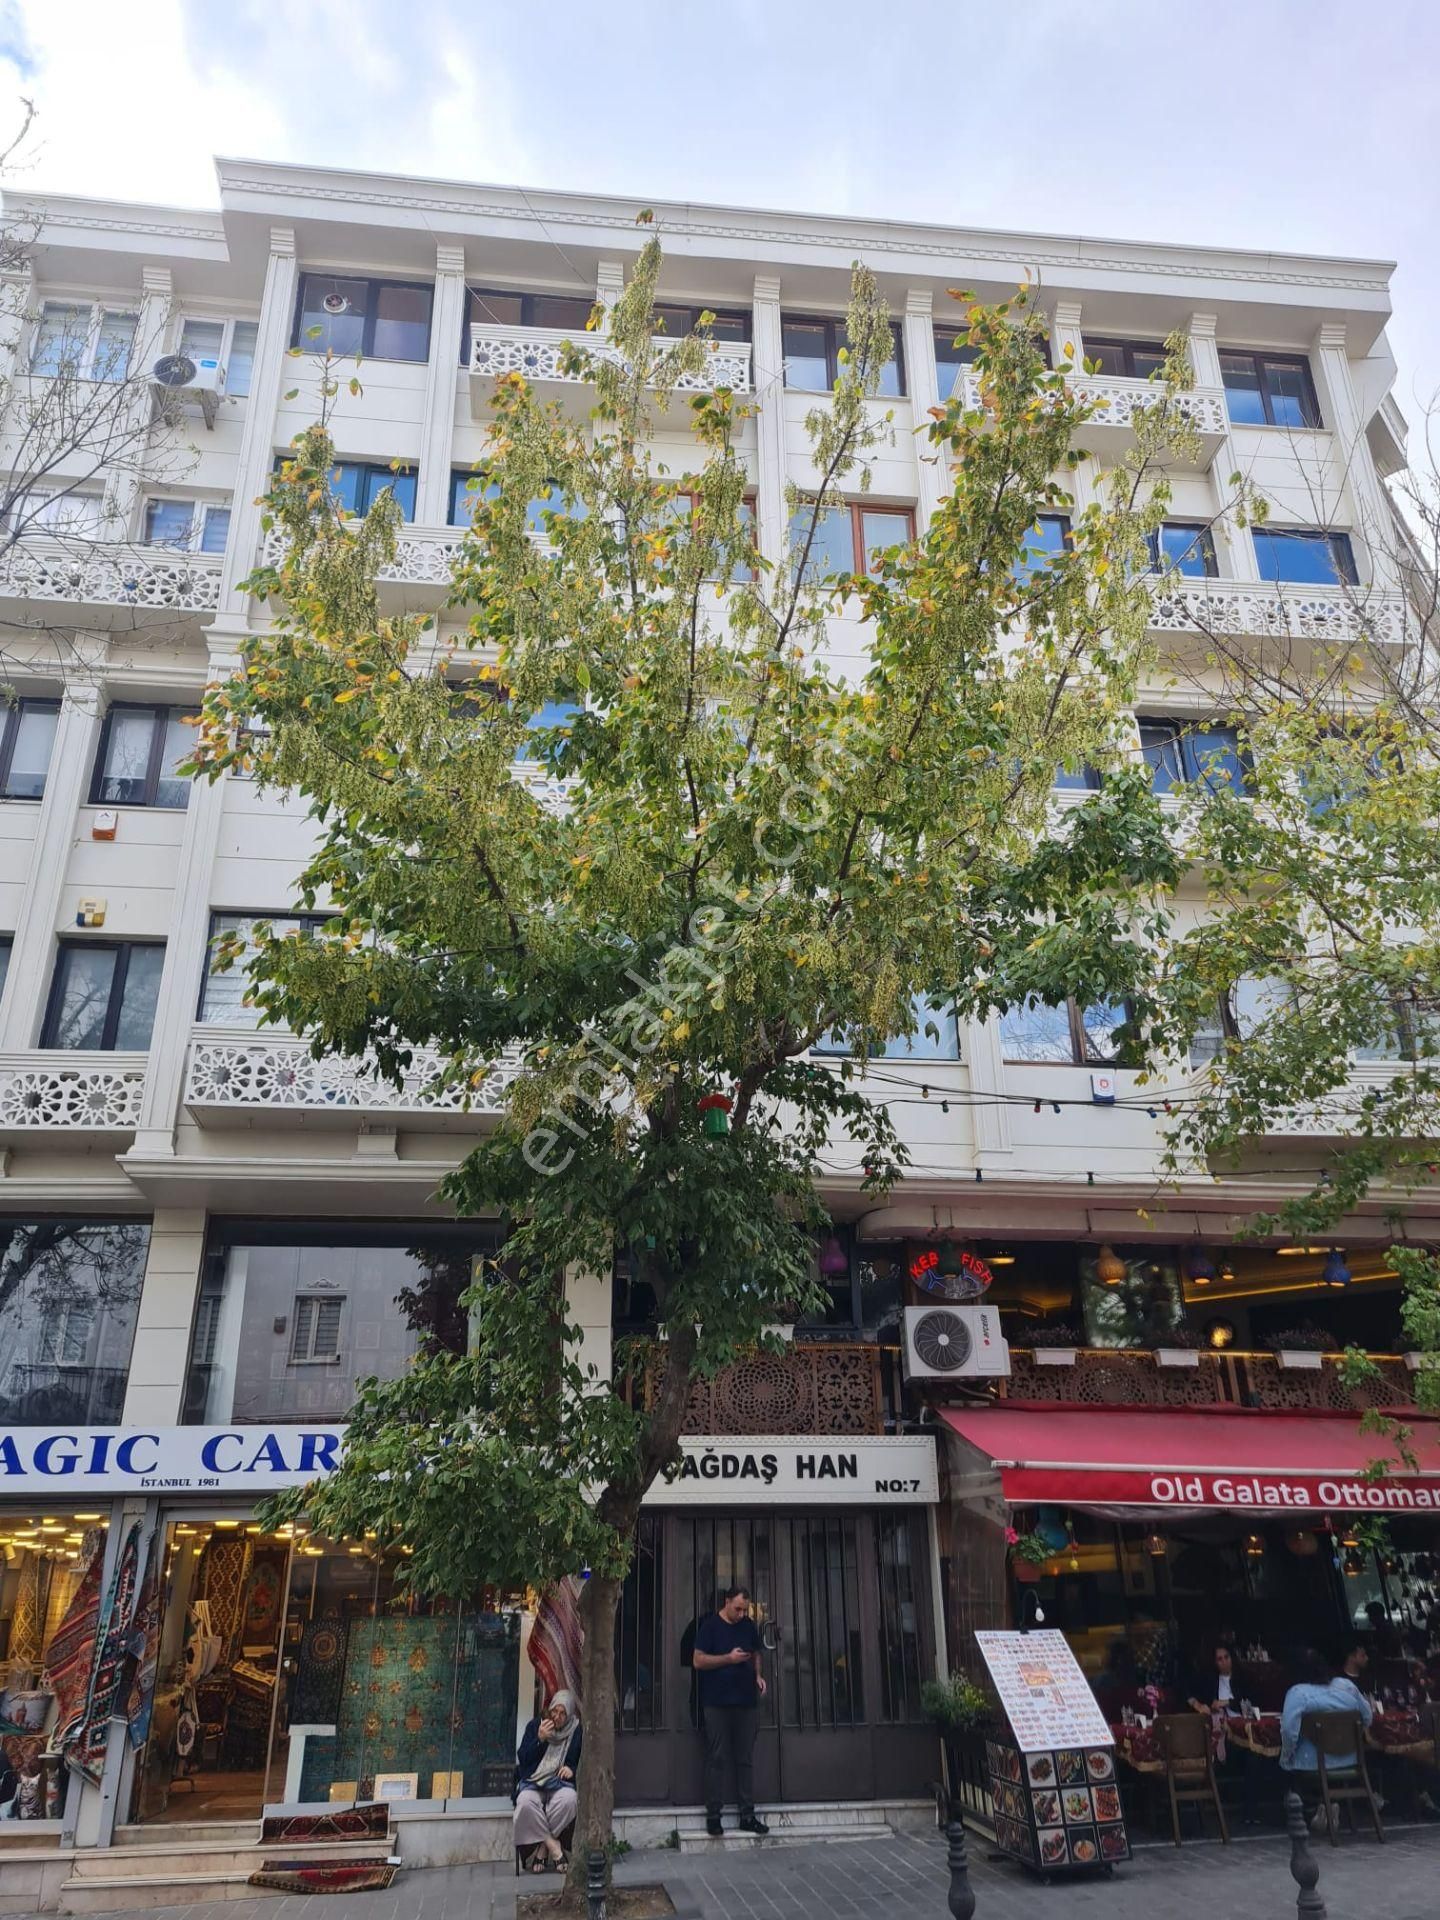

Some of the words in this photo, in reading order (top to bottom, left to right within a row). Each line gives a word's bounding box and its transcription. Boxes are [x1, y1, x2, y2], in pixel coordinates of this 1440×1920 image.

[910, 1251, 940, 1279] KEB
[961, 1253, 994, 1284] FISH
[200, 1433, 345, 1472] CAR
[796, 1454, 858, 1479] HAN
[140, 1477, 192, 1487] İSTANBUL
[197, 1478, 220, 1487] 1981
[875, 1479, 920, 1493] NO:7
[1150, 1477, 1204, 1502] Old
[1212, 1479, 1310, 1505] Galata
